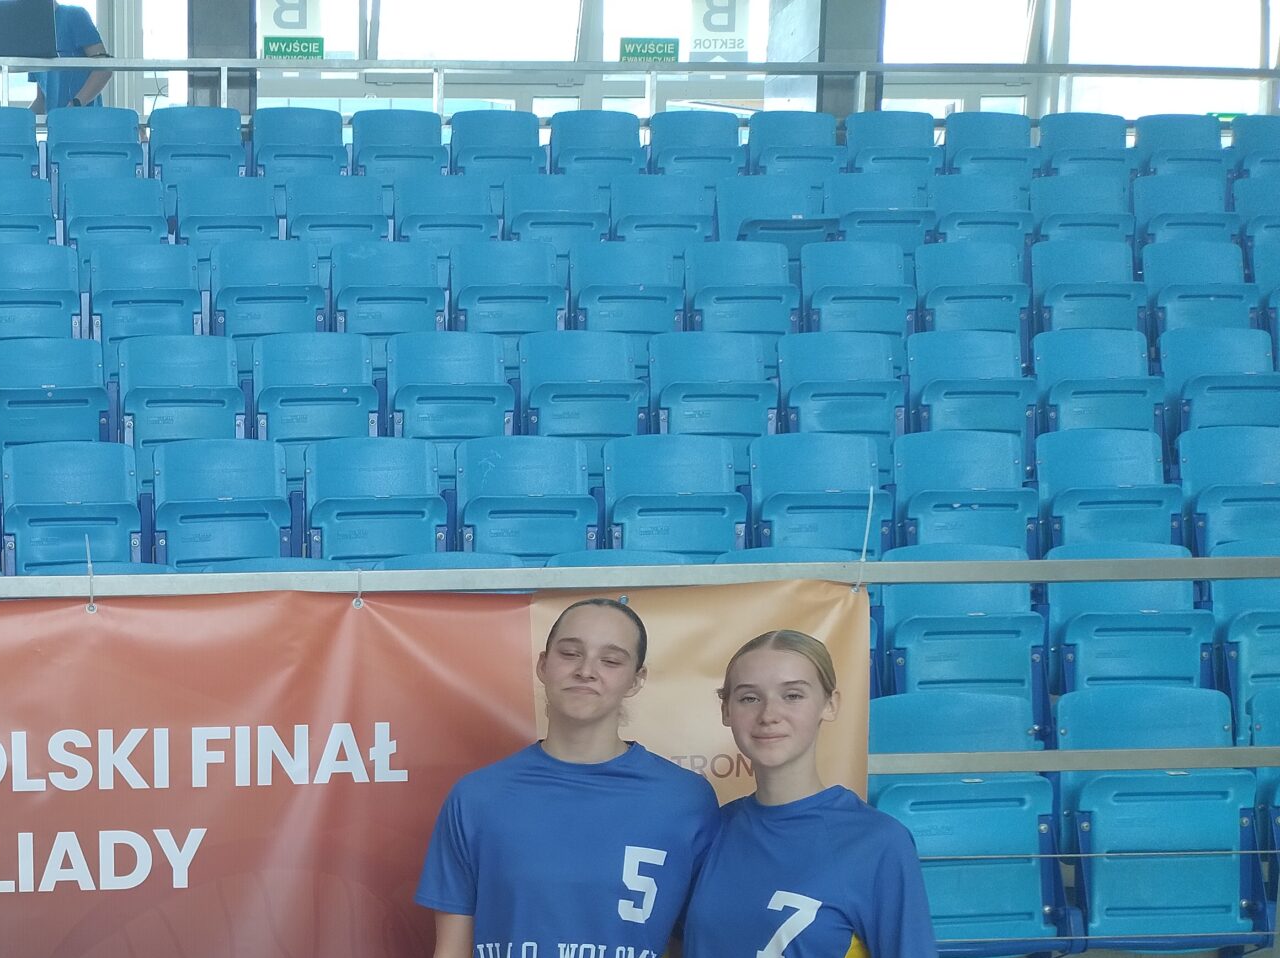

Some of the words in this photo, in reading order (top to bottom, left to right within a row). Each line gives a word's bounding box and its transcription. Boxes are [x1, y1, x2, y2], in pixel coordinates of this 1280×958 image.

[269, 40, 320, 53] WYJŚCIE
[624, 43, 675, 54] WYJŚCIE
[191, 721, 409, 788] FINAŁ
[618, 845, 667, 924] 5
